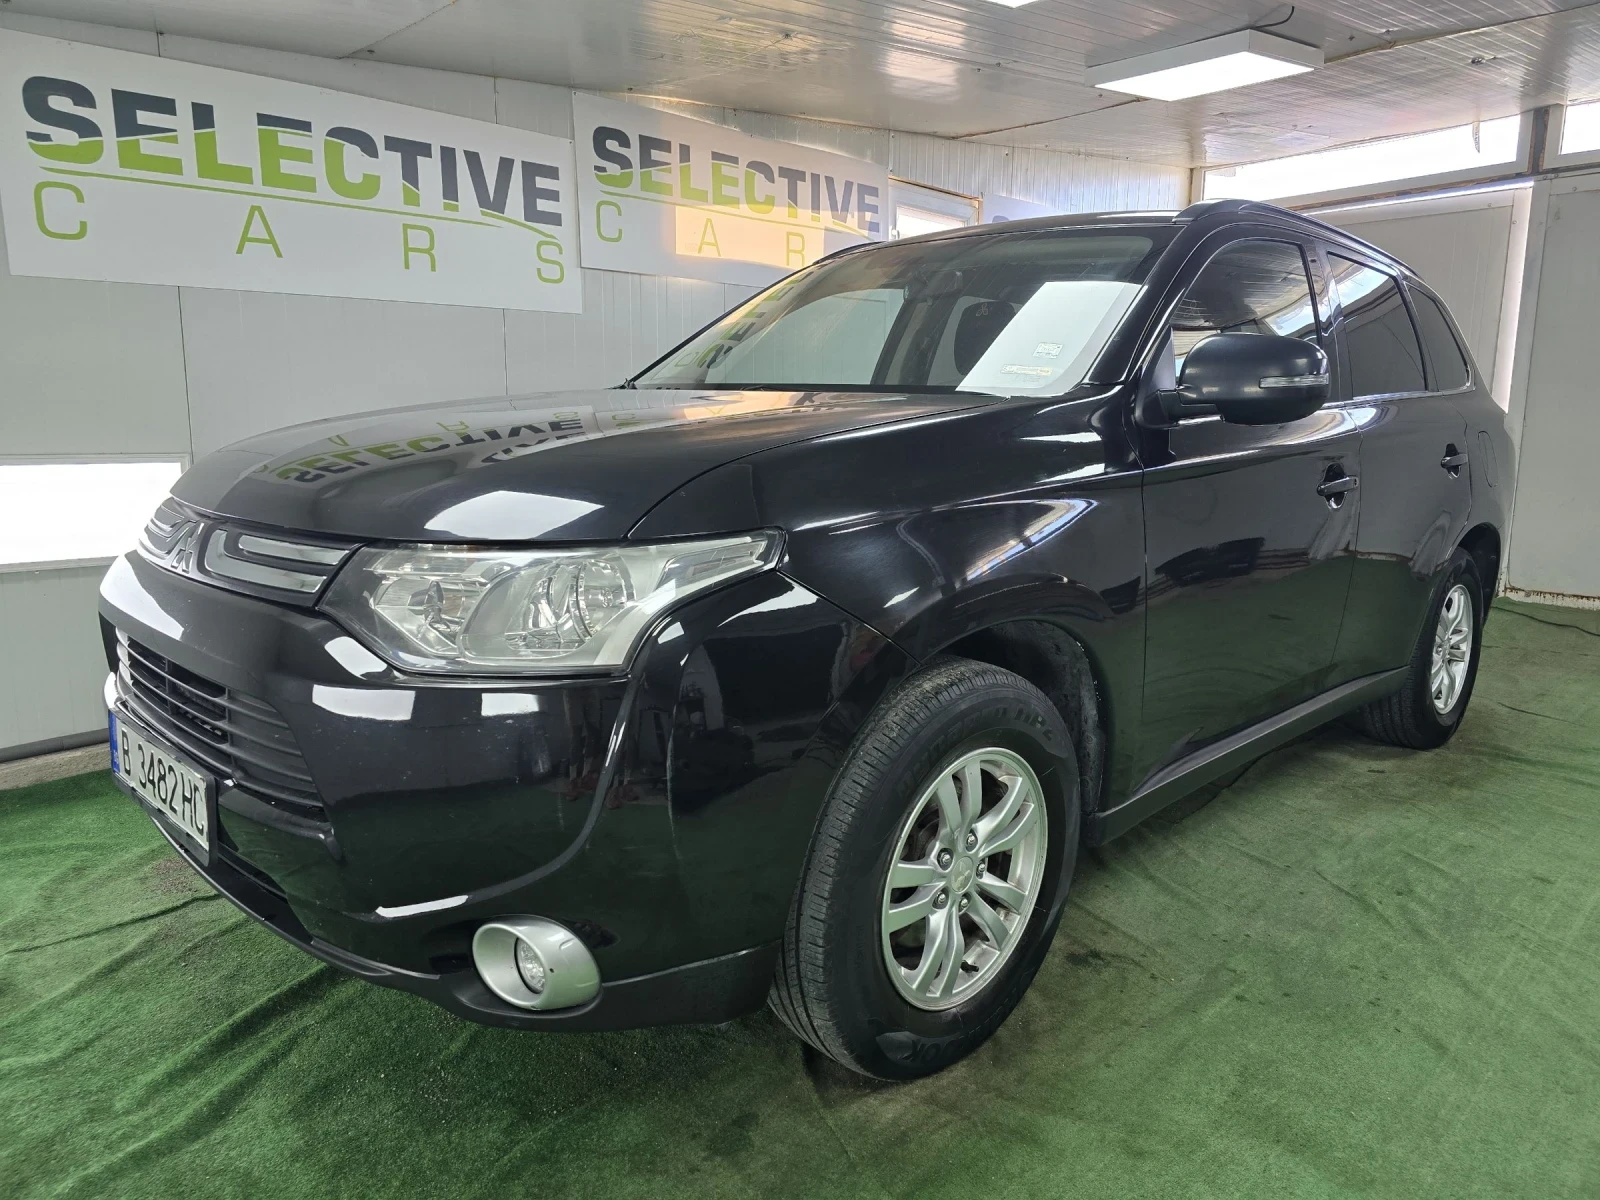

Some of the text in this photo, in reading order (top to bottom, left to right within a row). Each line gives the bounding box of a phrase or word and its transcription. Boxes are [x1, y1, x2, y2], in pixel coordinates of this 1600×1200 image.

[22, 75, 562, 227] SELECTIVE
[592, 126, 880, 234] SELECTIVE
[33, 180, 566, 284] CARS
[595, 200, 806, 268] CAR
[121, 728, 204, 836] B 3482 HC
